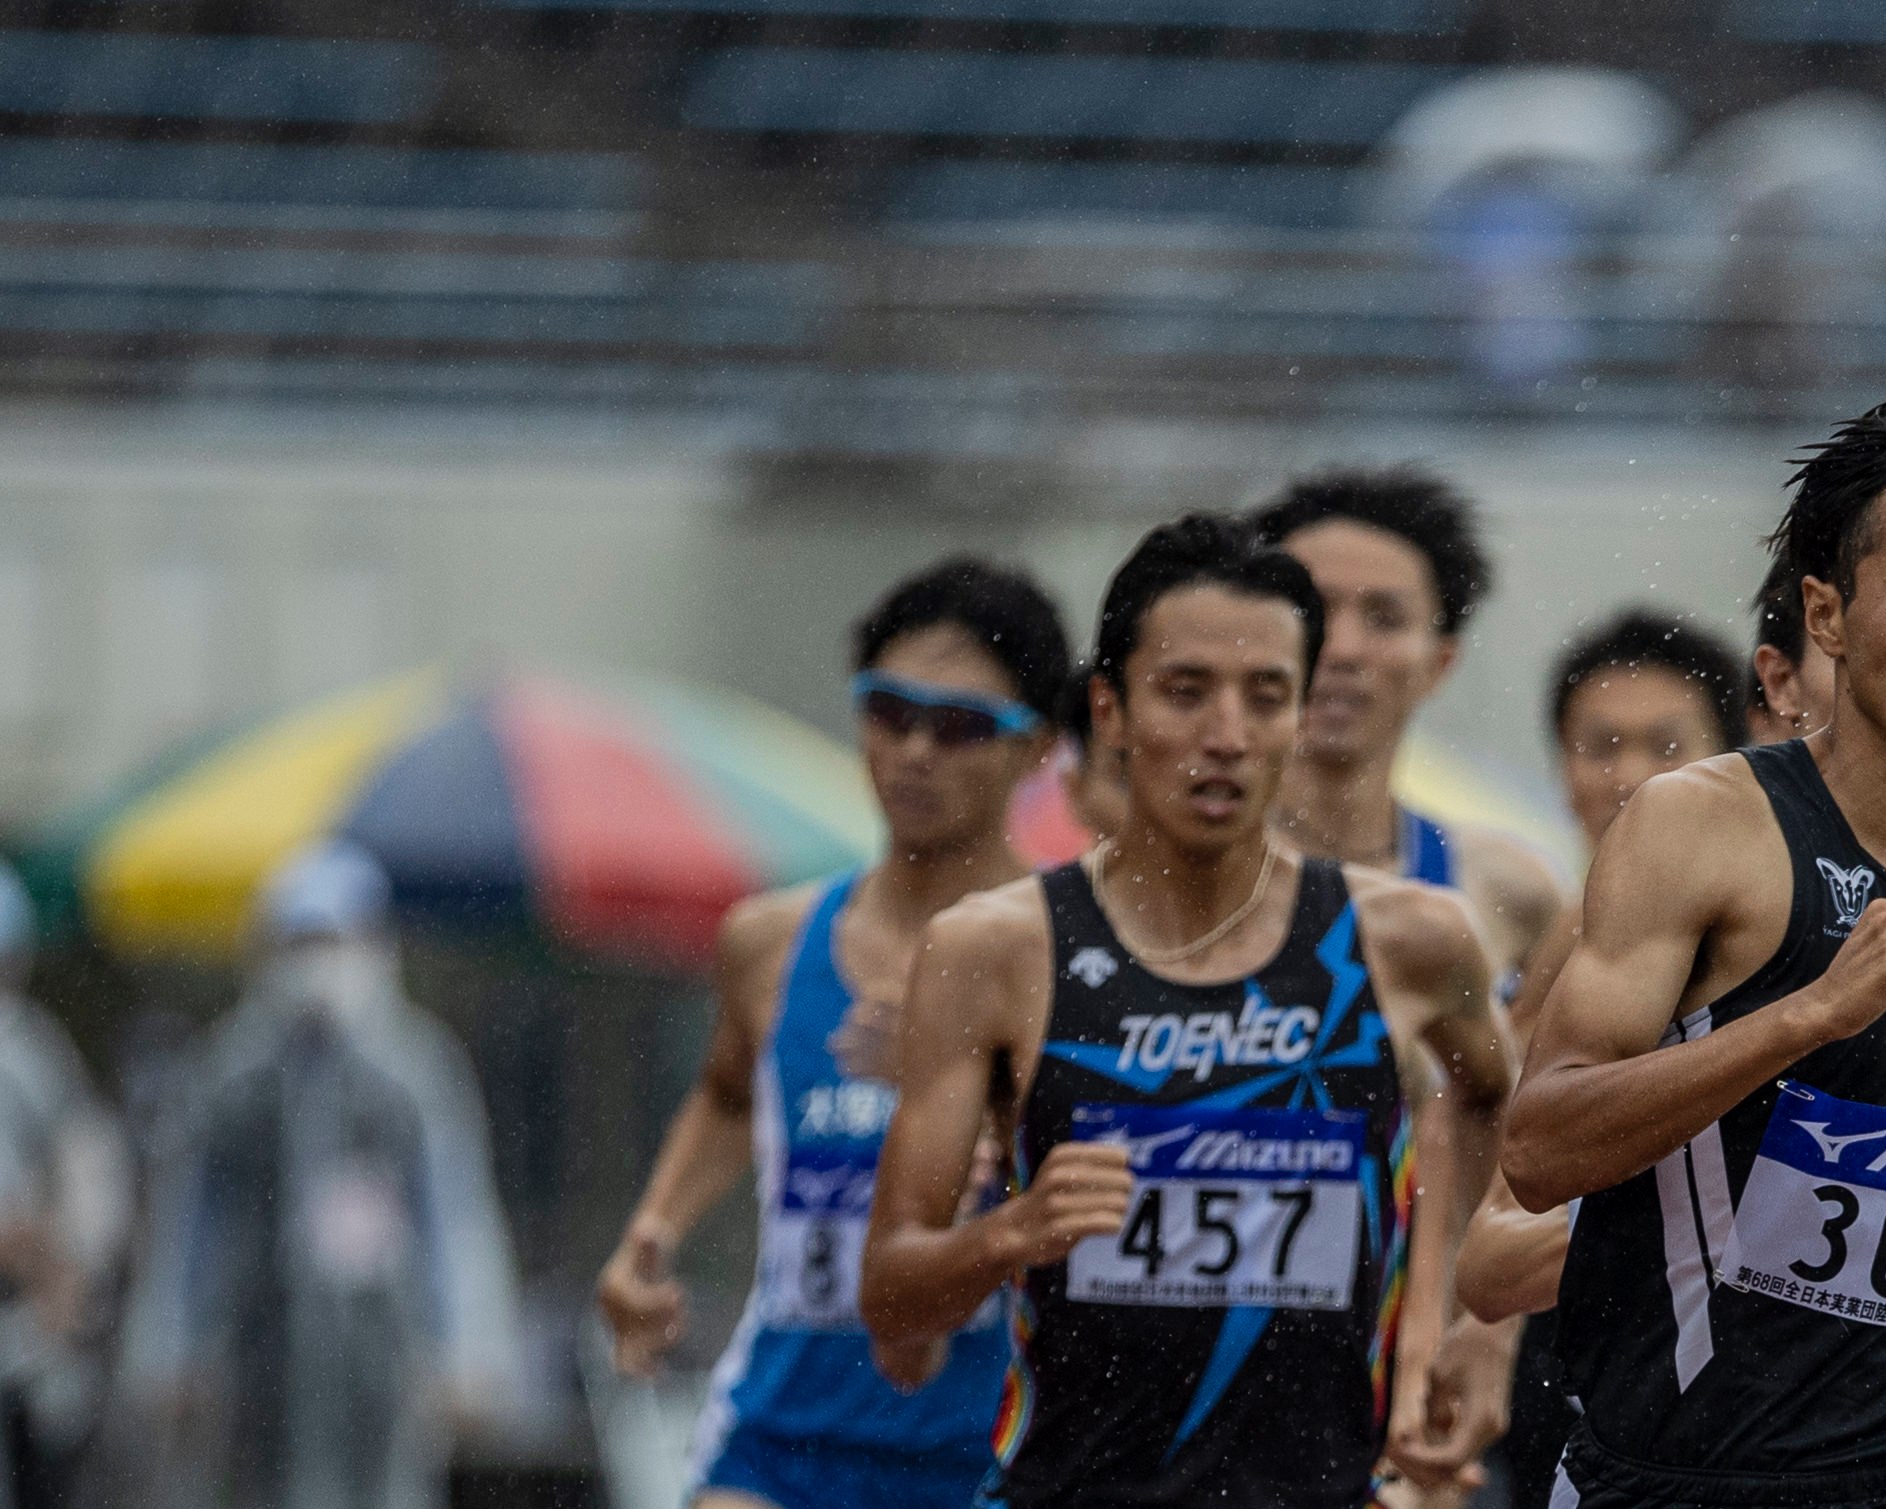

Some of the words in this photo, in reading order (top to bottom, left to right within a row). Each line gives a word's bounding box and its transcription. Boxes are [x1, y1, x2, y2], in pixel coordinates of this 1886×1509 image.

[1116, 996, 1320, 1082] TOENEC
[1176, 1131, 1353, 1170] MIZUNO
[1120, 1188, 1315, 1278] 457
